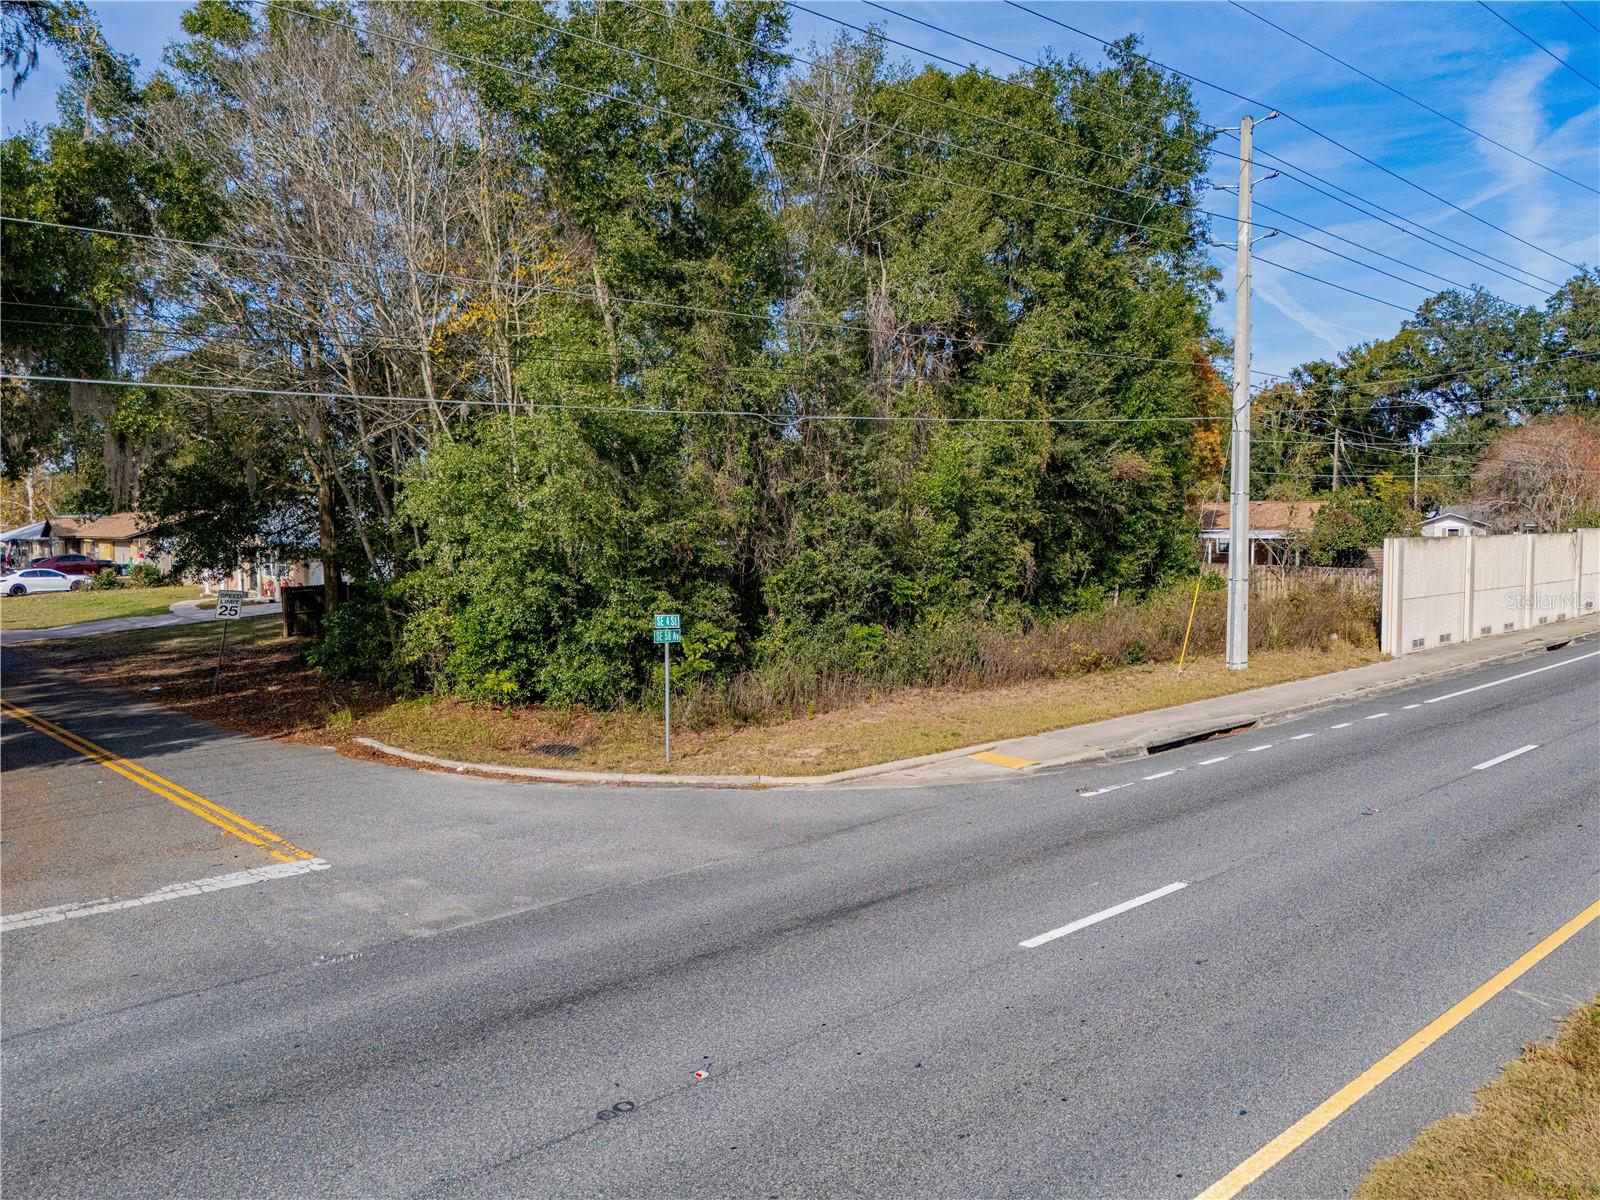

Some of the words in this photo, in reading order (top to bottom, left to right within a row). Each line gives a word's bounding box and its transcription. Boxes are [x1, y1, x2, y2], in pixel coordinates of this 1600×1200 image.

[218, 605, 238, 616] 25
[656, 616, 664, 626] SE
[665, 616, 670, 626] 4
[656, 631, 663, 641] SE
